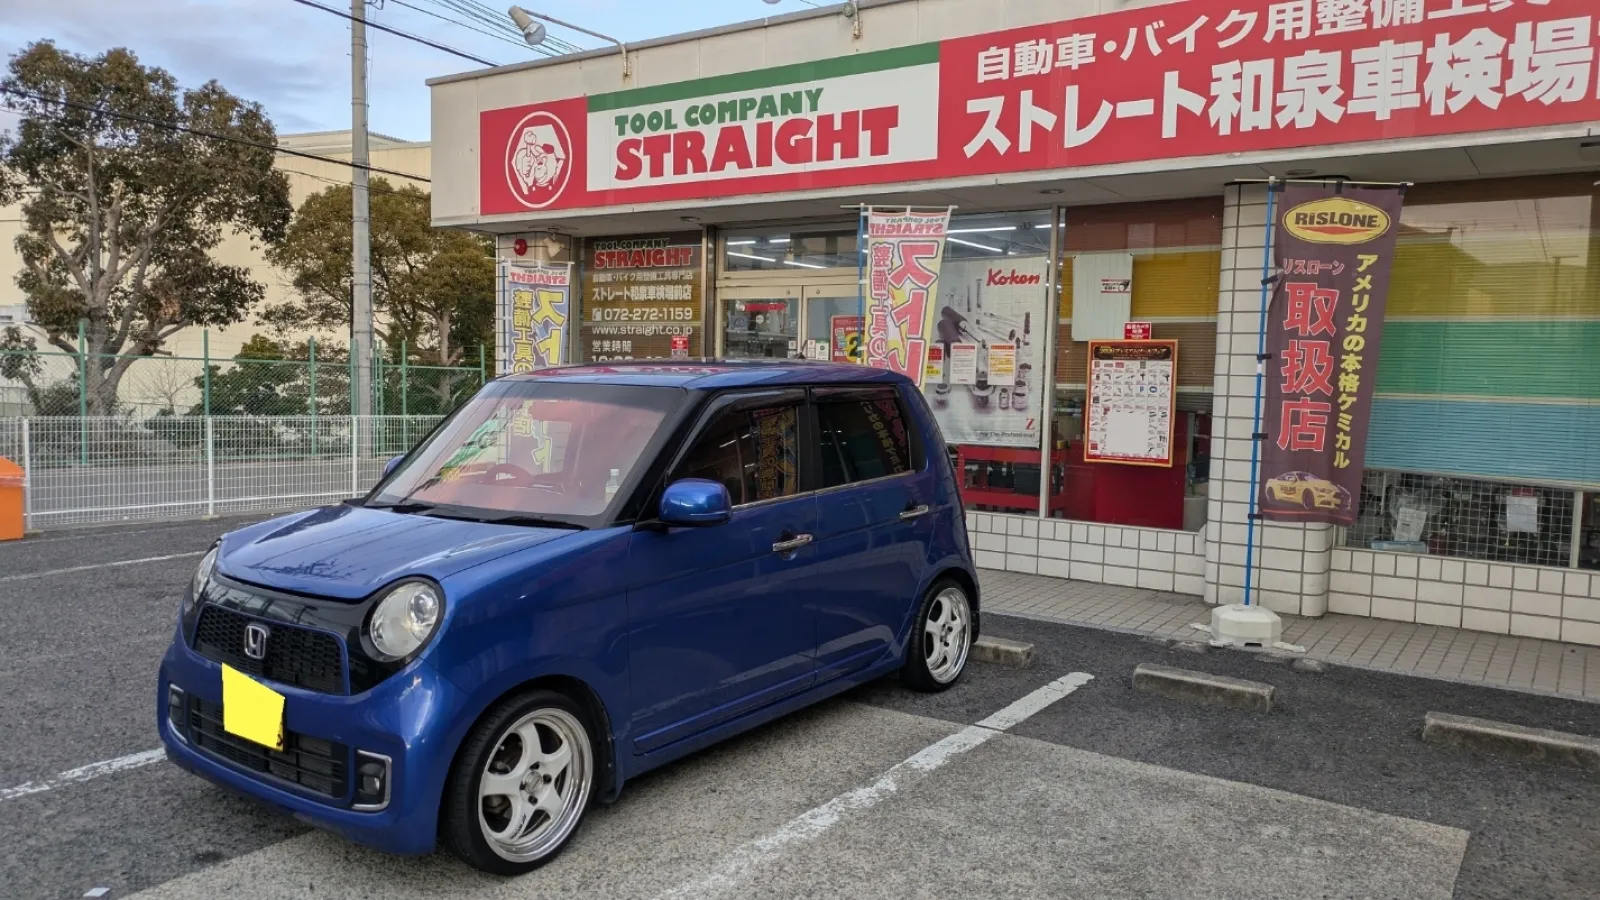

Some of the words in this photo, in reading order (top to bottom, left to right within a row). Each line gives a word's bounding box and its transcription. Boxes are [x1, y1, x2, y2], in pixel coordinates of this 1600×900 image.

[963, 15, 1600, 159] ストレート和泉車検場
[614, 108, 677, 136] TOOL
[684, 87, 824, 125] COMPANY
[614, 105, 899, 181] STRAIGHT
[594, 241, 620, 250] TOOL
[620, 238, 670, 249] COMPANY
[594, 247, 692, 269] STRAIGHT
[1283, 258, 1345, 276] リスローン
[986, 267, 1041, 287] Koken
[604, 307, 693, 321] 072-272-1159
[592, 324, 693, 337] www.straight.co.jp
[592, 339, 632, 353] 営業時間
[1276, 281, 1340, 452] 取扱店
[1333, 254, 1378, 469] アメリカの本格ケミカル
